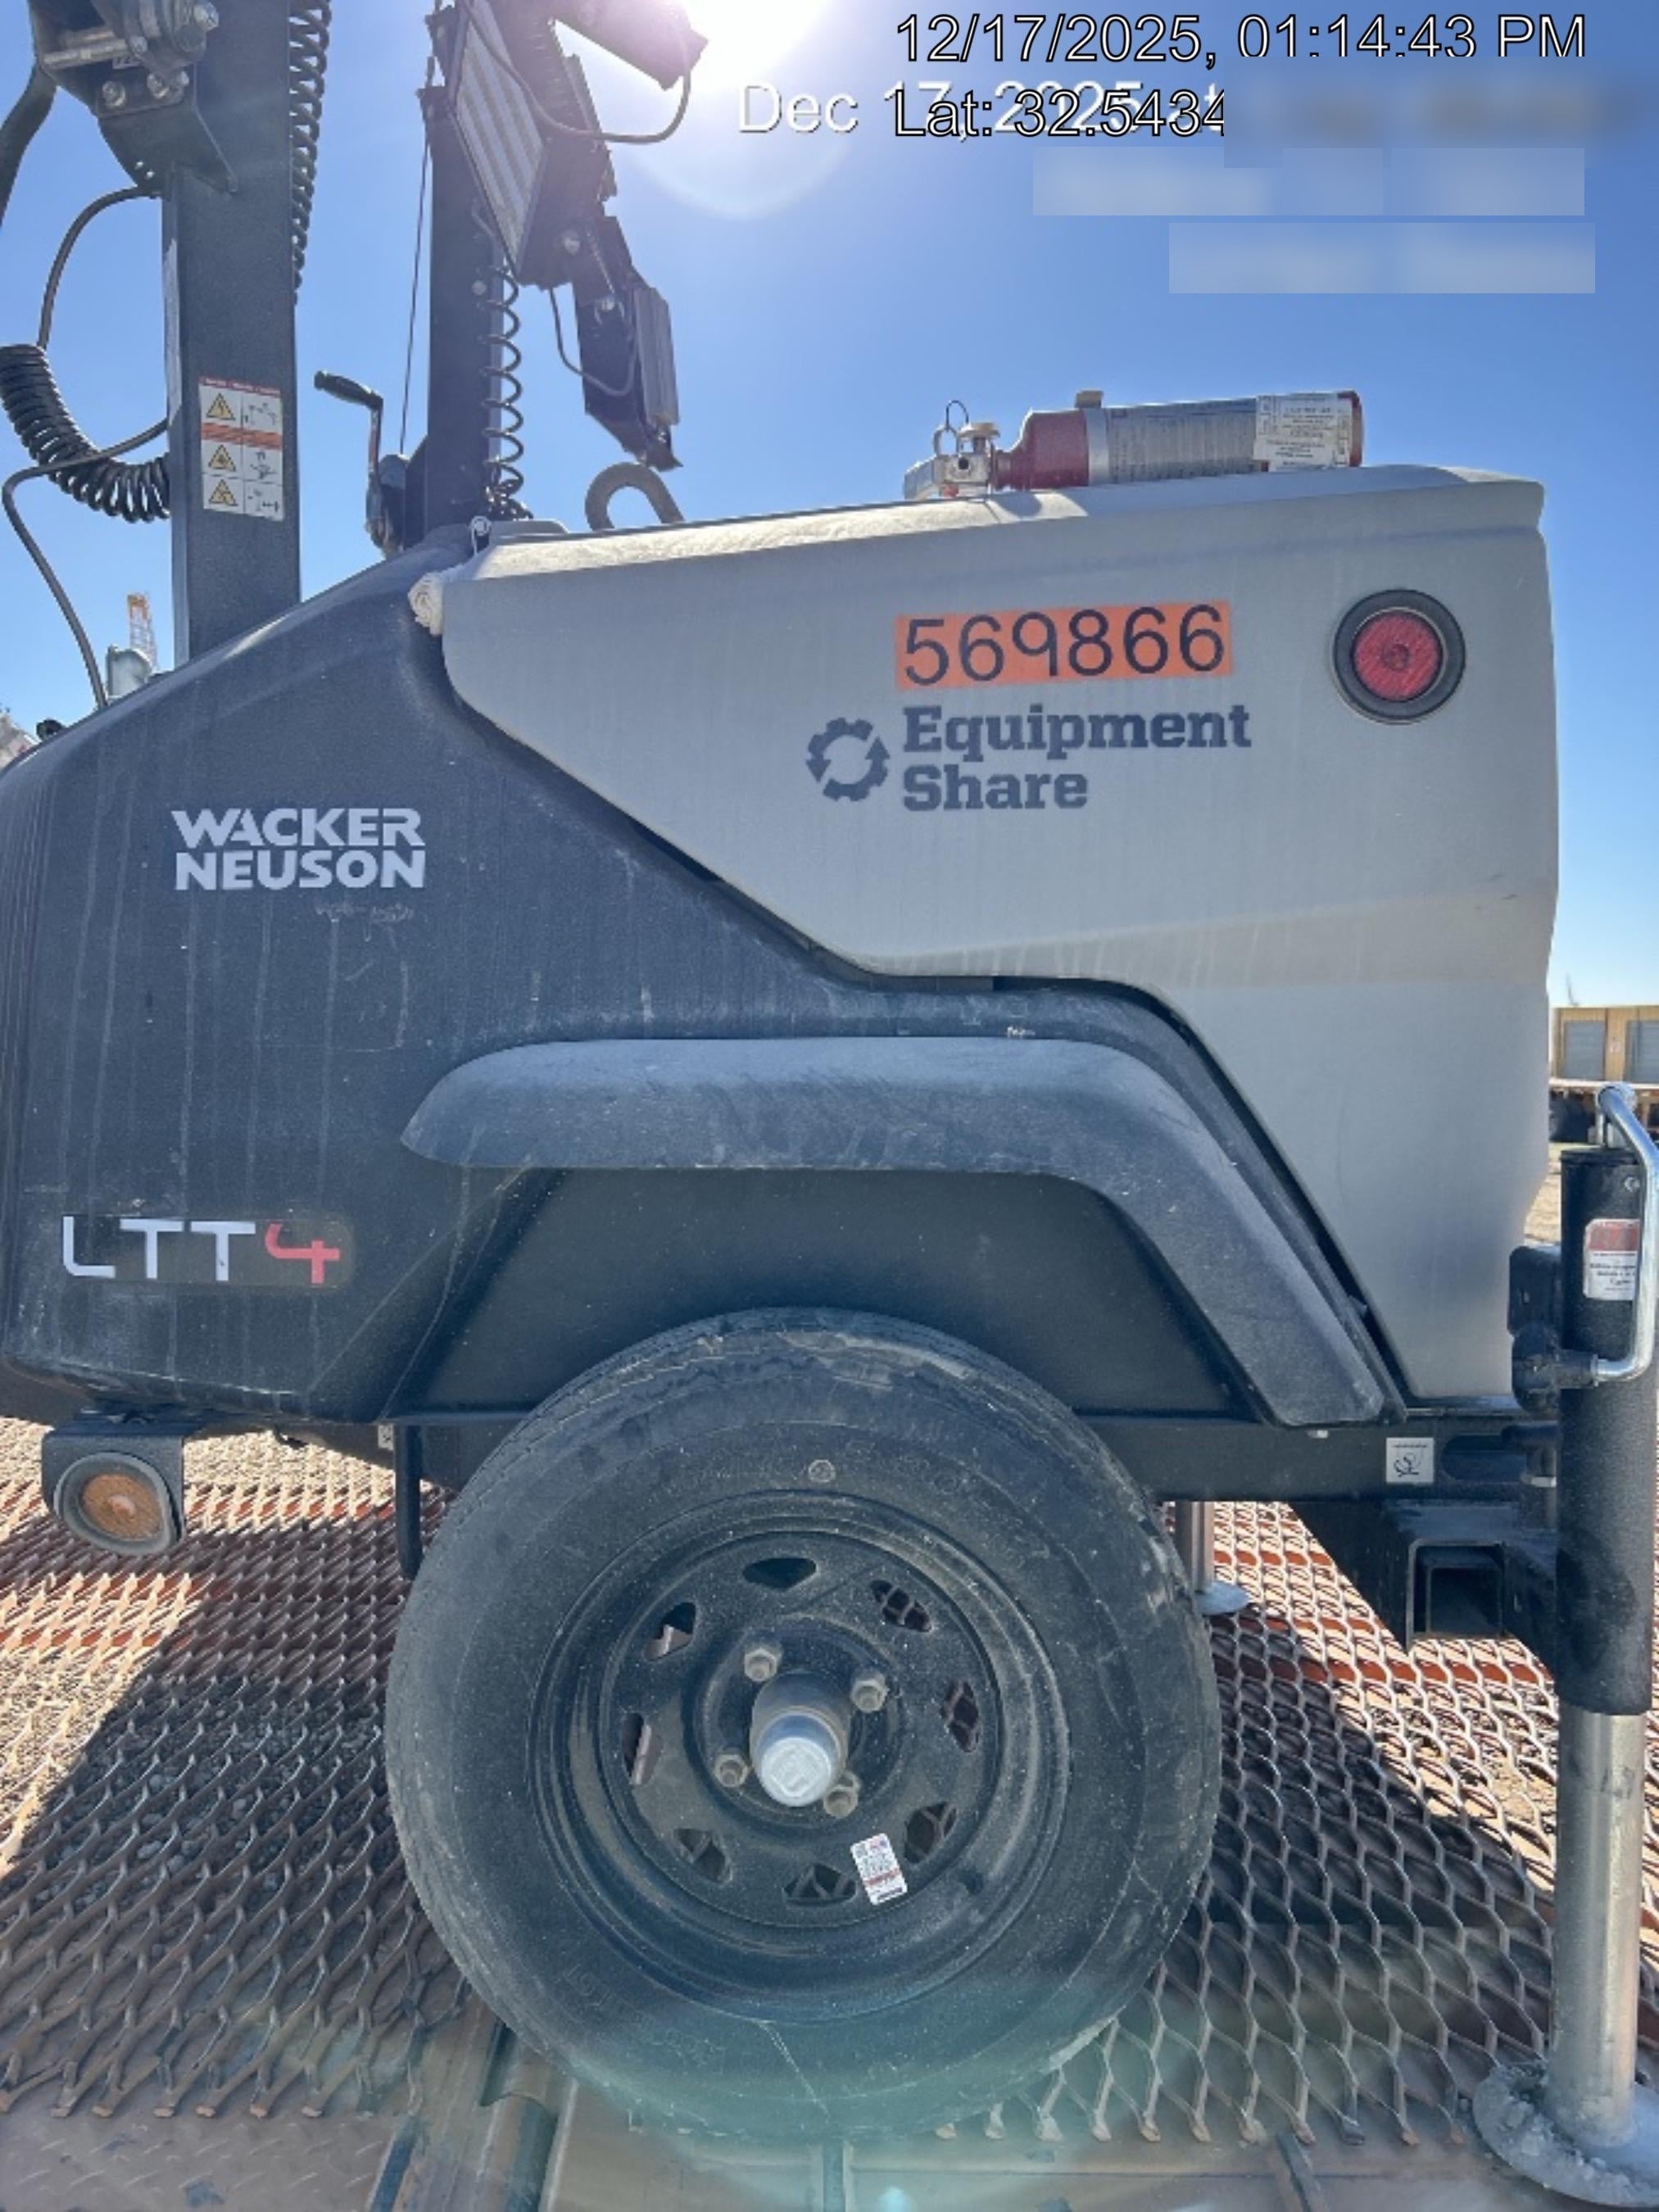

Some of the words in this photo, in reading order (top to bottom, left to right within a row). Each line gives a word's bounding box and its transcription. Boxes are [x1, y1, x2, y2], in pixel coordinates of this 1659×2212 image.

[904, 604, 1225, 686] 569866
[903, 703, 1252, 762] Equipment
[903, 764, 1089, 811] Share
[171, 809, 425, 847] WACKER
[175, 850, 426, 890] NEUSON
[63, 1216, 340, 1284] LTT4
